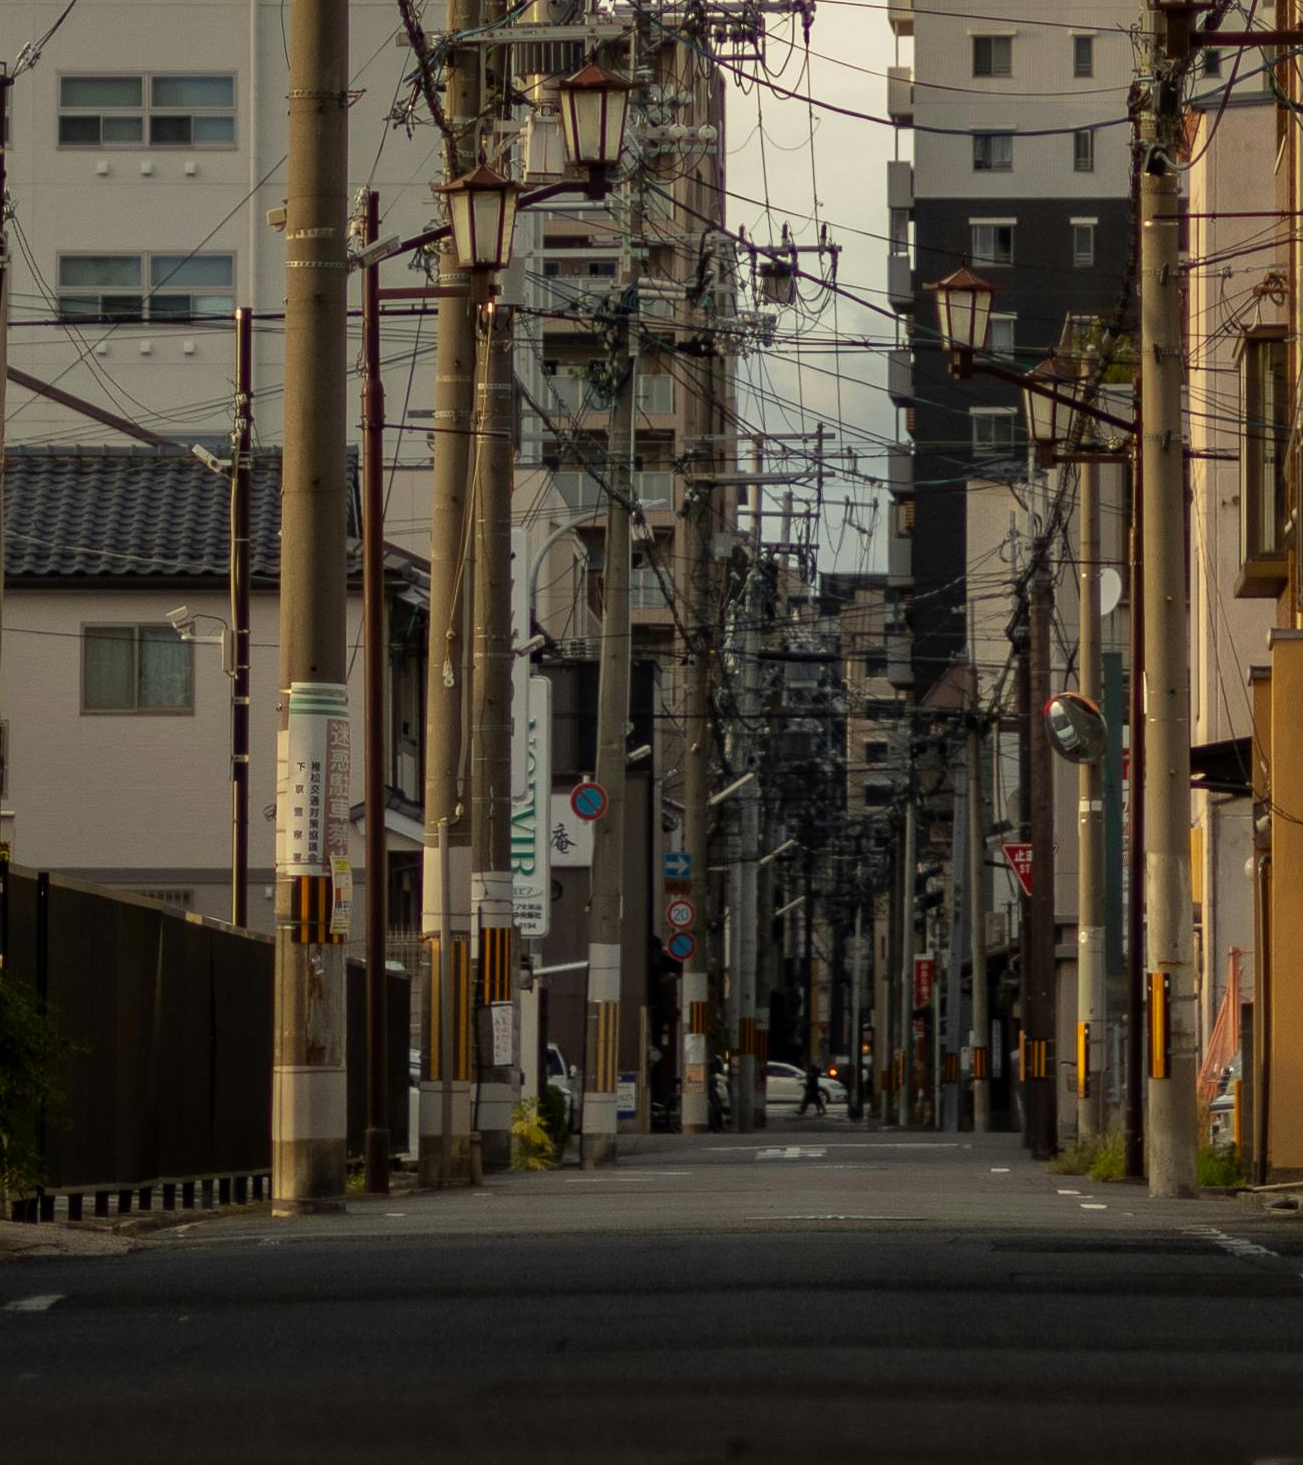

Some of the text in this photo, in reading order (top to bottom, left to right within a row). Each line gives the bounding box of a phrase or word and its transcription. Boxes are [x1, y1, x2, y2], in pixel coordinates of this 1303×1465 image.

[328, 722, 350, 855] 迷惑駐車禁
[673, 907, 689, 921] 20
